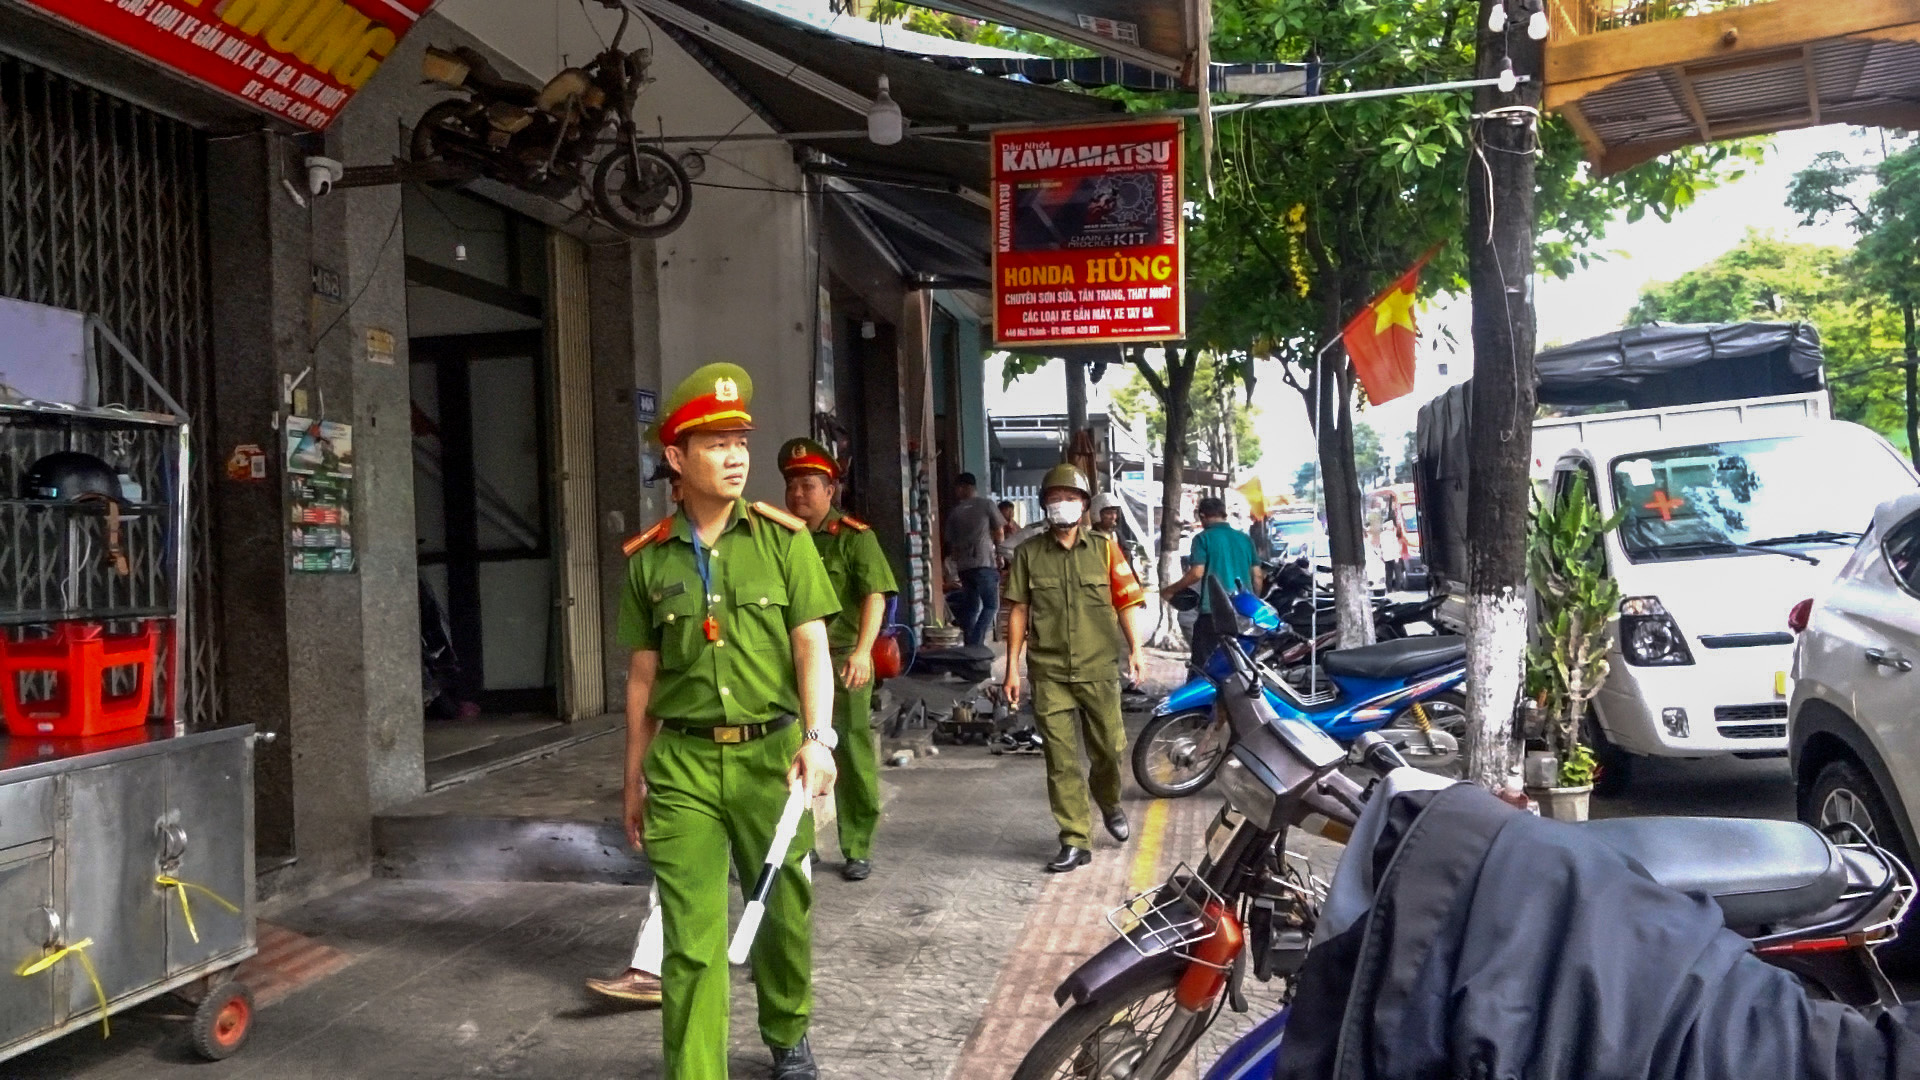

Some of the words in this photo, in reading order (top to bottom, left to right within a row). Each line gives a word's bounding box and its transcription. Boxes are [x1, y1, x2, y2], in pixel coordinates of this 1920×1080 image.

[173, 15, 201, 40] XE
[240, 48, 266, 71] XE
[1002, 140, 1171, 171] KAWAMATSU
[999, 184, 1011, 252] KAWAMATSU
[1162, 174, 1176, 245] KAWAMATSU
[1113, 232, 1149, 246] KIT
[1005, 265, 1075, 287] HONDA
[1086, 251, 1172, 284] HÙNG
[1127, 287, 1148, 300] THAY
[1060, 309, 1072, 322] XE
[1113, 307, 1125, 320] XE
